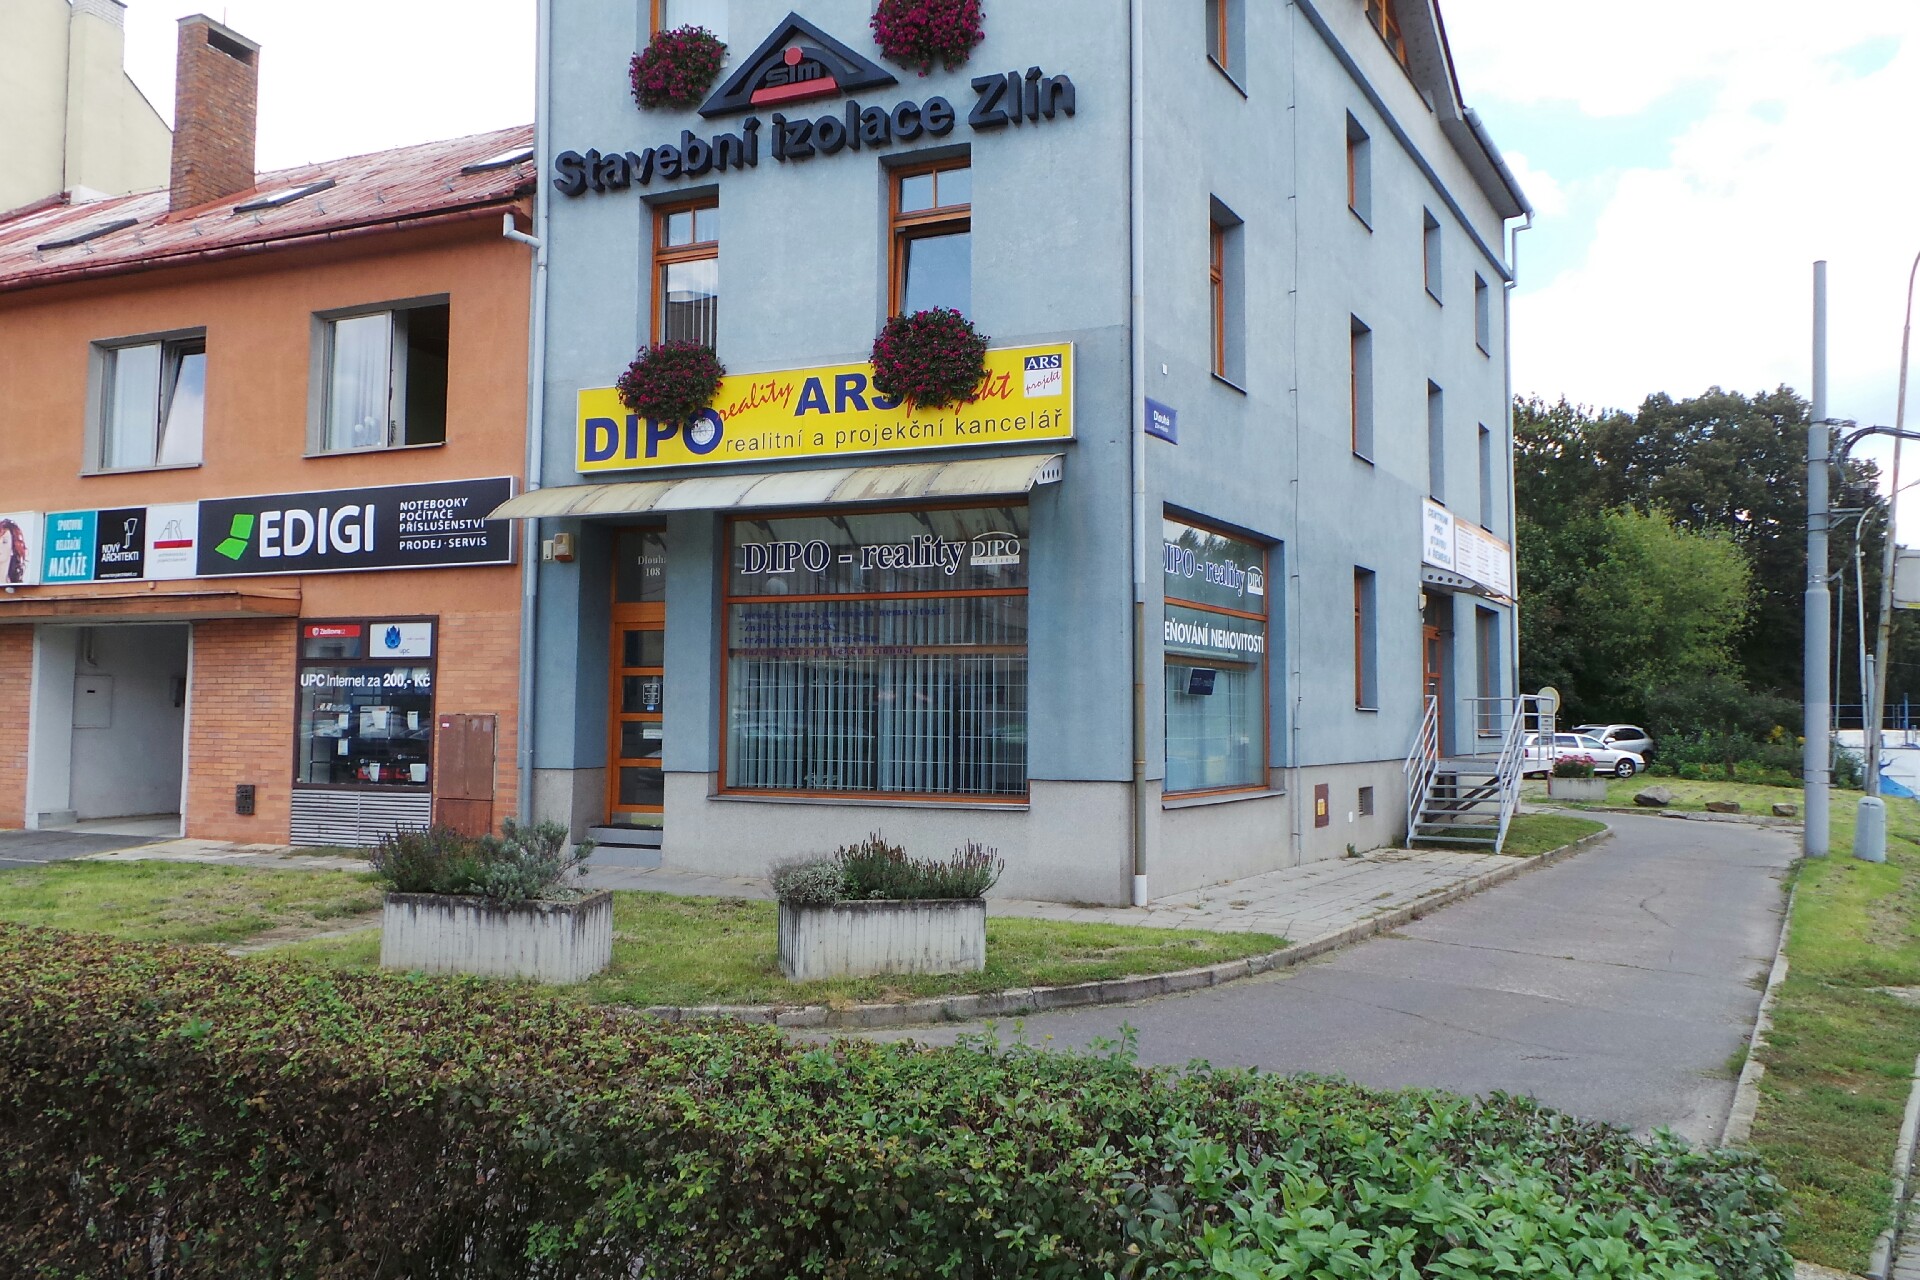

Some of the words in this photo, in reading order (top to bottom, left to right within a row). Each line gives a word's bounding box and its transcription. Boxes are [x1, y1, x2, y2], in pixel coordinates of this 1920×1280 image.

[553, 117, 760, 196] Stavební
[771, 96, 955, 162] izolace
[968, 66, 1075, 131] Zlín
[1026, 355, 1060, 370] ARS
[1024, 371, 1062, 394] projekt
[584, 407, 724, 463] DIPO
[716, 379, 795, 421] reality
[726, 429, 803, 453] realitní
[813, 433, 825, 446] a
[836, 418, 944, 448] projekční
[955, 408, 1064, 435] kancelář
[400, 498, 468, 510] NOTEBOOKY
[399, 508, 453, 521] POČÍTAČE
[259, 504, 375, 557] EDIGI
[399, 517, 485, 532] PŘÍSLUŠENSTVÍ
[101, 542, 121, 554] NOVÝ
[101, 551, 139, 562] ARCHITEKTI
[741, 539, 831, 575] DIPO
[860, 533, 967, 576] reality
[971, 540, 1020, 557] DIPO
[48, 552, 87, 577] MASÁŽE
[638, 555, 666, 565] Dlouh
[645, 568, 661, 576] 108
[1163, 543, 1195, 578] IPO
[1206, 559, 1246, 597] reality
[1211, 628, 1264, 654] NEMOVITOSTÍ
[300, 673, 325, 687] UPC
[327, 673, 366, 687] Internet
[367, 677, 380, 687] za
[383, 673, 412, 689] 200,-
[414, 673, 431, 687] Kč
